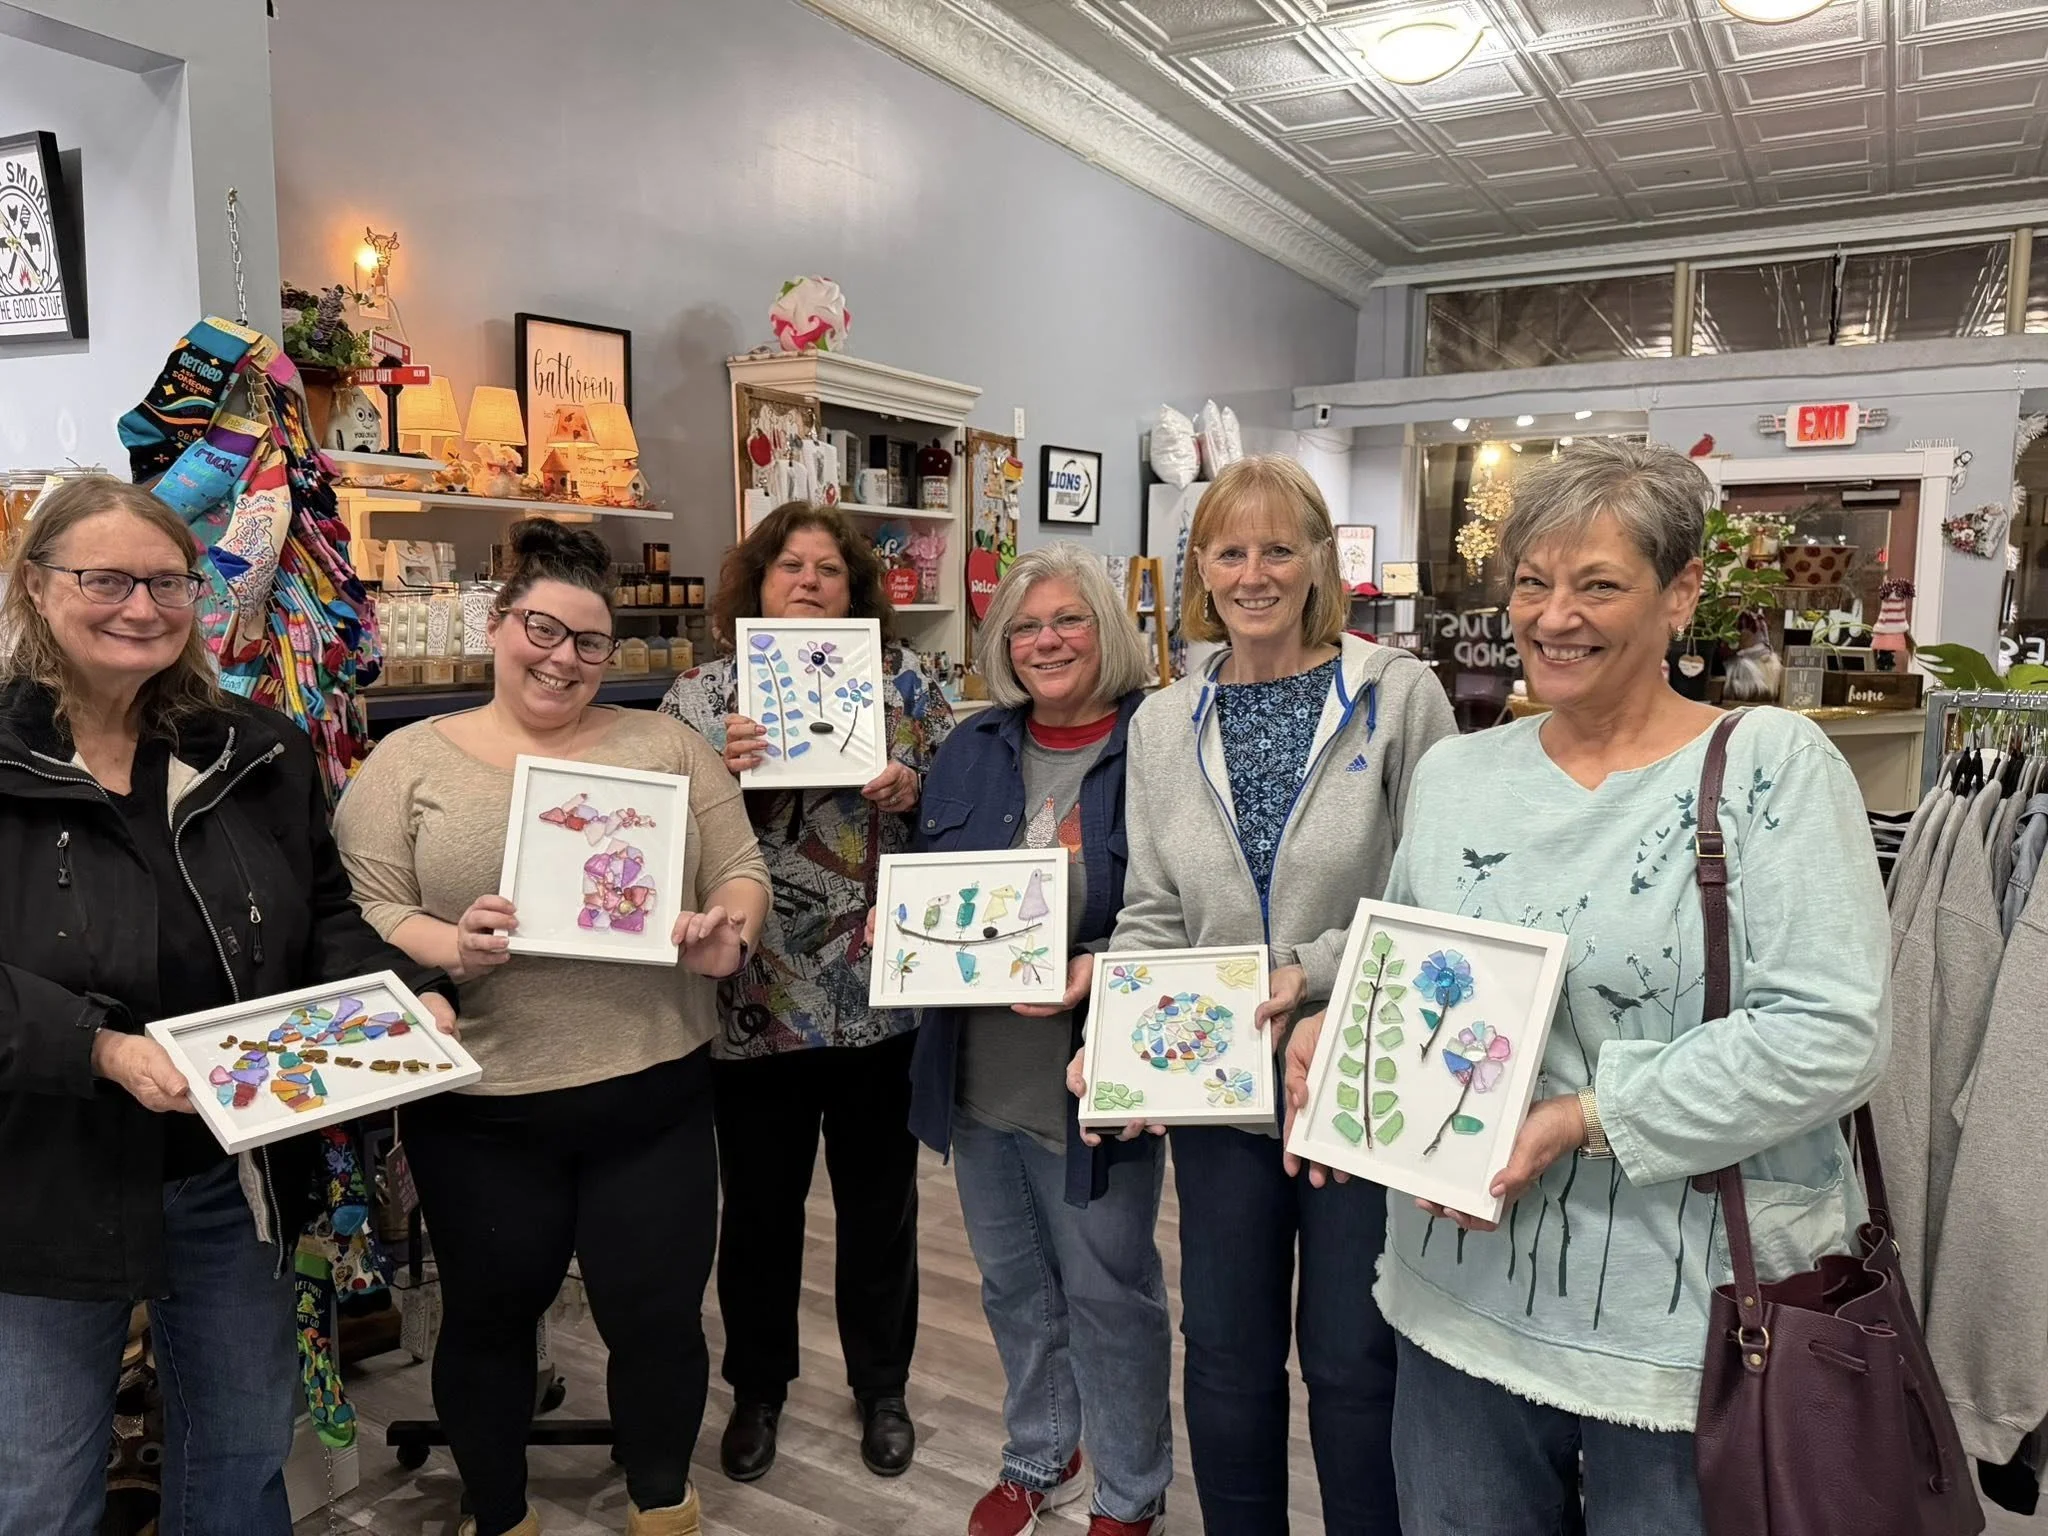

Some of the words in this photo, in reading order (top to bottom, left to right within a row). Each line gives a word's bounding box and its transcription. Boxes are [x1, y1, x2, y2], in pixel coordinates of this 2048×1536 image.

[13, 298, 37, 319] GOOD
[39, 295, 61, 317] STUF
[172, 370, 213, 396] SOMEONE
[355, 368, 374, 383] IND
[376, 368, 392, 383] OUT
[534, 348, 618, 404] bathroom
[181, 382, 198, 394] ELSE
[1797, 404, 1849, 441] EXIT
[1913, 439, 1932, 448] SAW
[1934, 438, 1955, 448] THAT
[1048, 471, 1081, 491] LIONS
[1848, 684, 1885, 703] home
